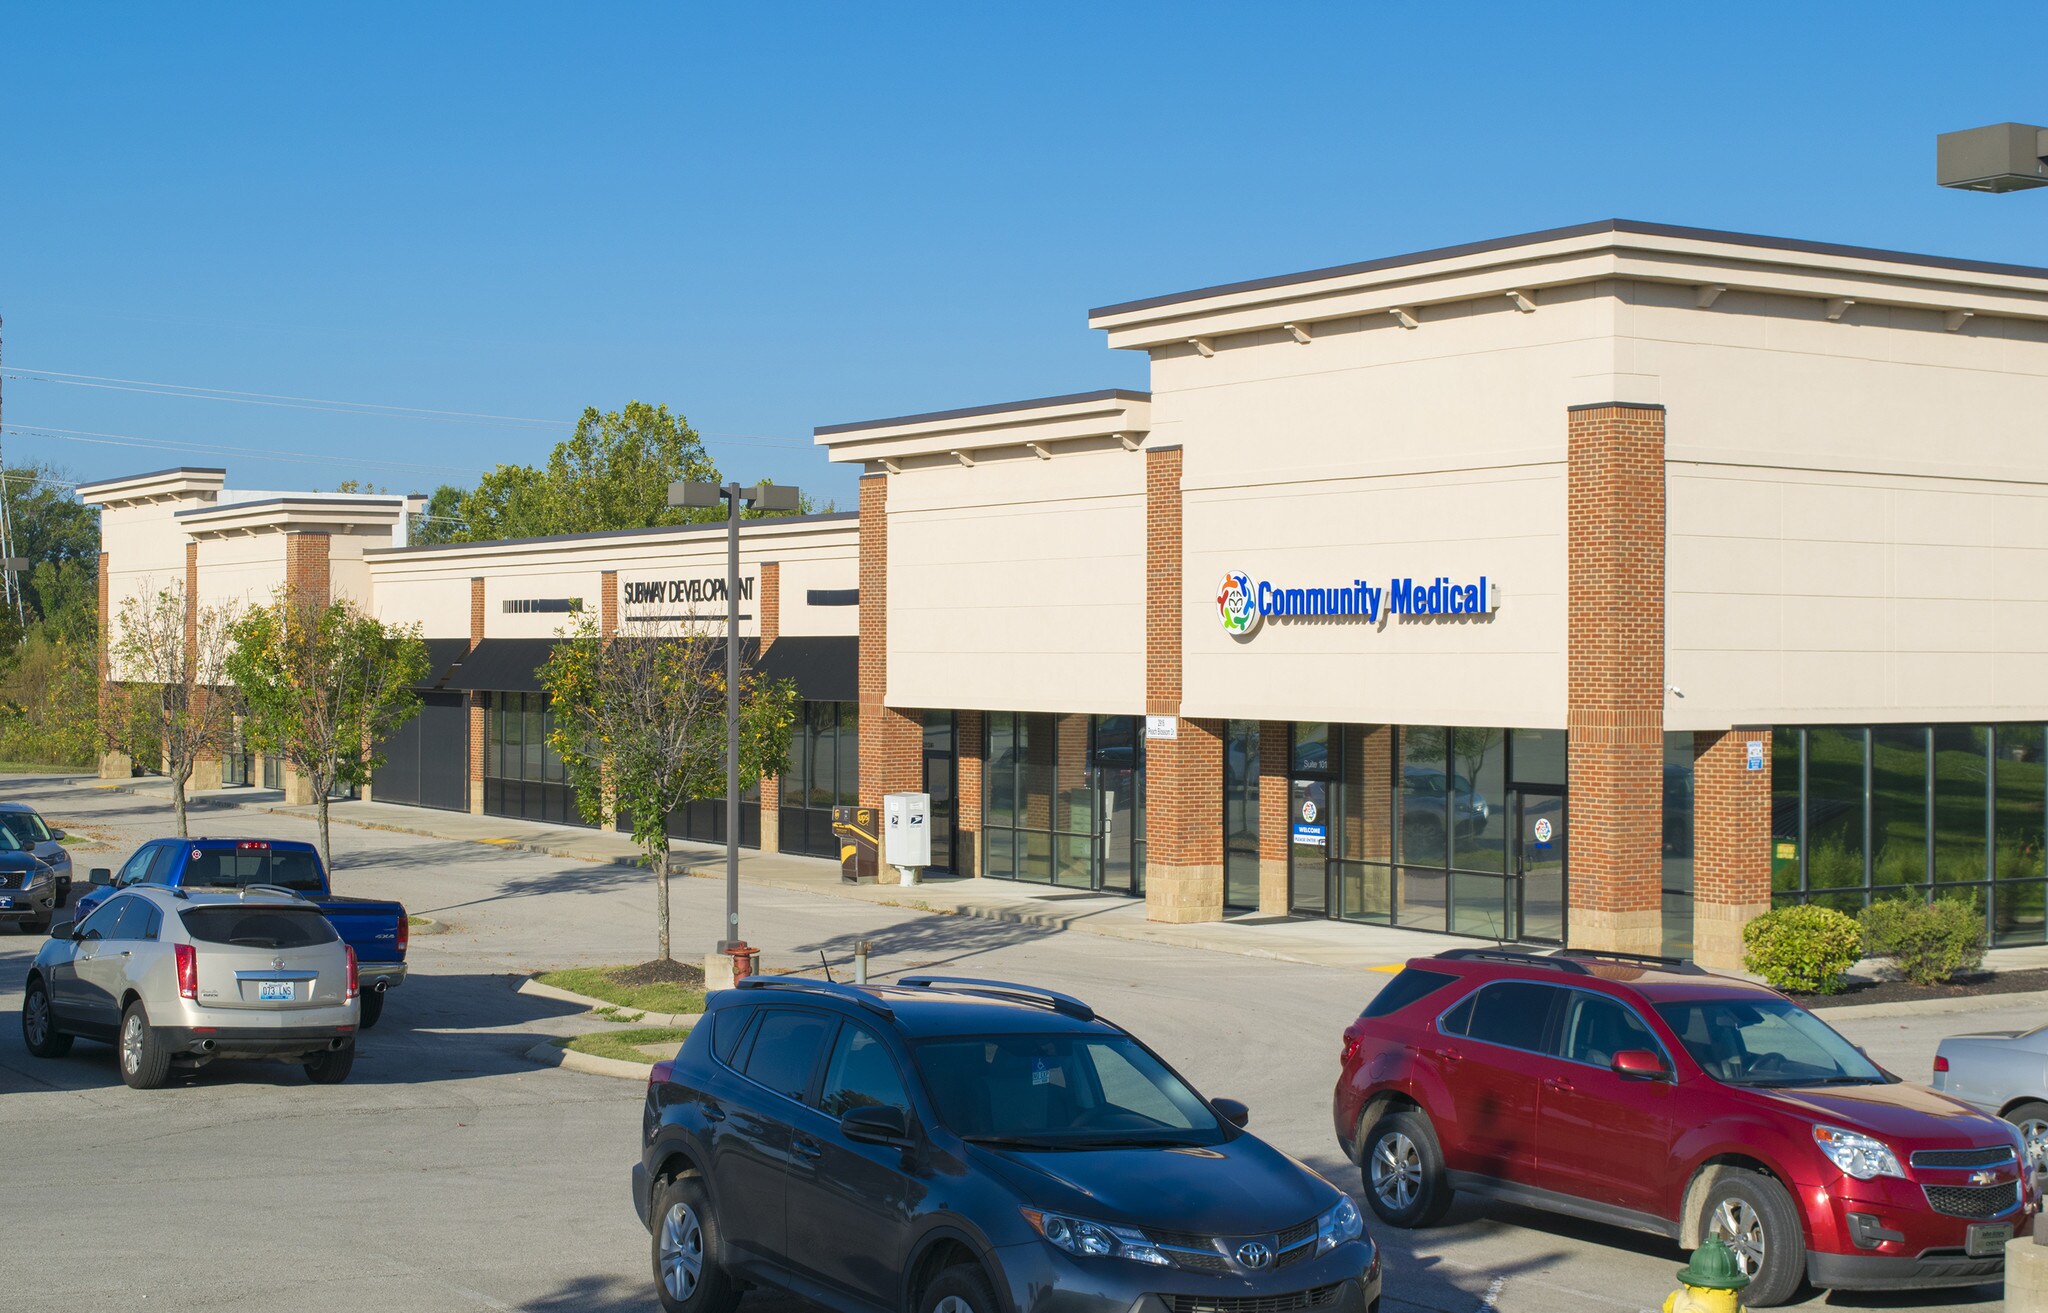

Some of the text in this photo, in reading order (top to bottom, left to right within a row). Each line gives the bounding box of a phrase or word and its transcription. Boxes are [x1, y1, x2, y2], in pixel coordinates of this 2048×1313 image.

[625, 577, 755, 604] SUBWAY DEVELOPMNT
[1258, 576, 1486, 622] Community Medical
[1303, 760, 1318, 768] Suite
[1298, 826, 1321, 834] WELCOME
[262, 986, 292, 996] 073 LNS
